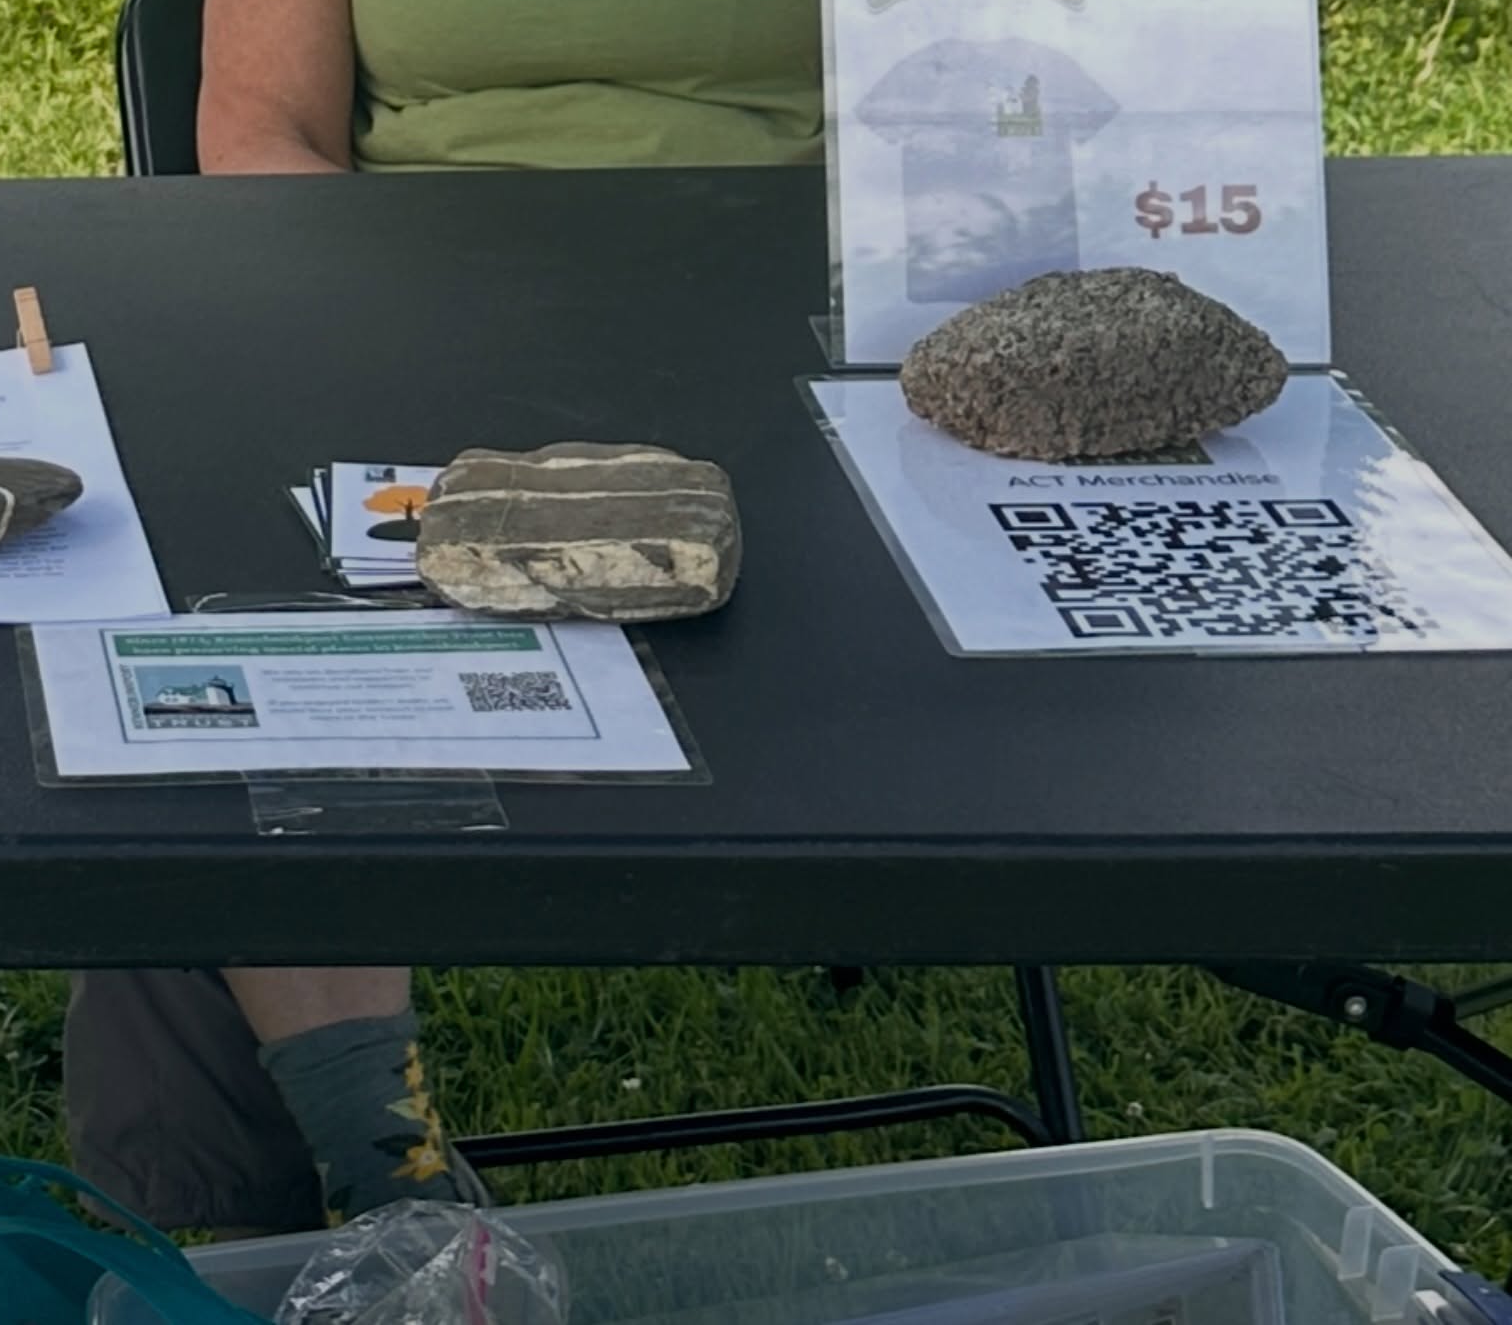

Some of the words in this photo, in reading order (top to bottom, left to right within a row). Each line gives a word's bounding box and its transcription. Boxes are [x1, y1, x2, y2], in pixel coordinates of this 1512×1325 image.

[1135, 181, 1262, 238] $15
[1009, 475, 1065, 488] ACT
[1076, 472, 1281, 488] Merchandise
